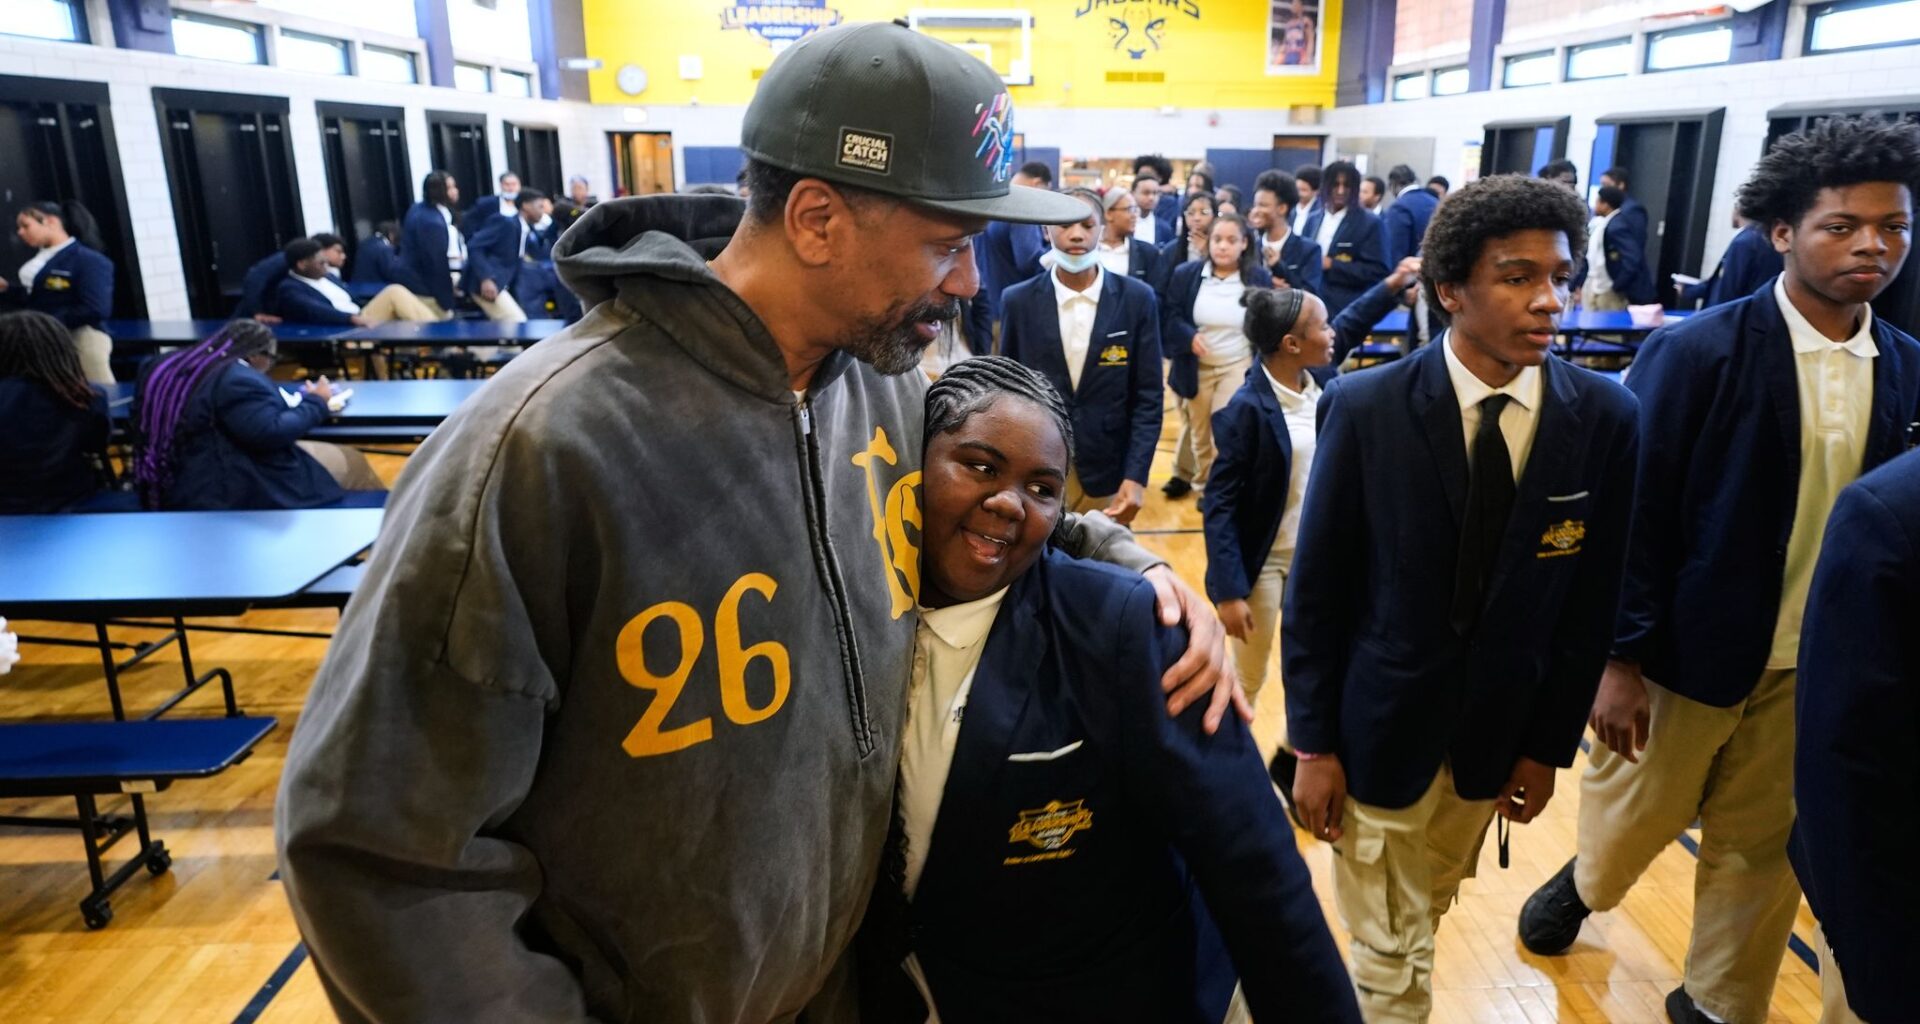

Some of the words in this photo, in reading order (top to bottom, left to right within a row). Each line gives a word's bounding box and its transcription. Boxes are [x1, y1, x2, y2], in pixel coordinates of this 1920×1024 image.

[845, 133, 888, 150] CRUCIAL
[843, 143, 888, 162] CATCH
[615, 571, 791, 758] 26
